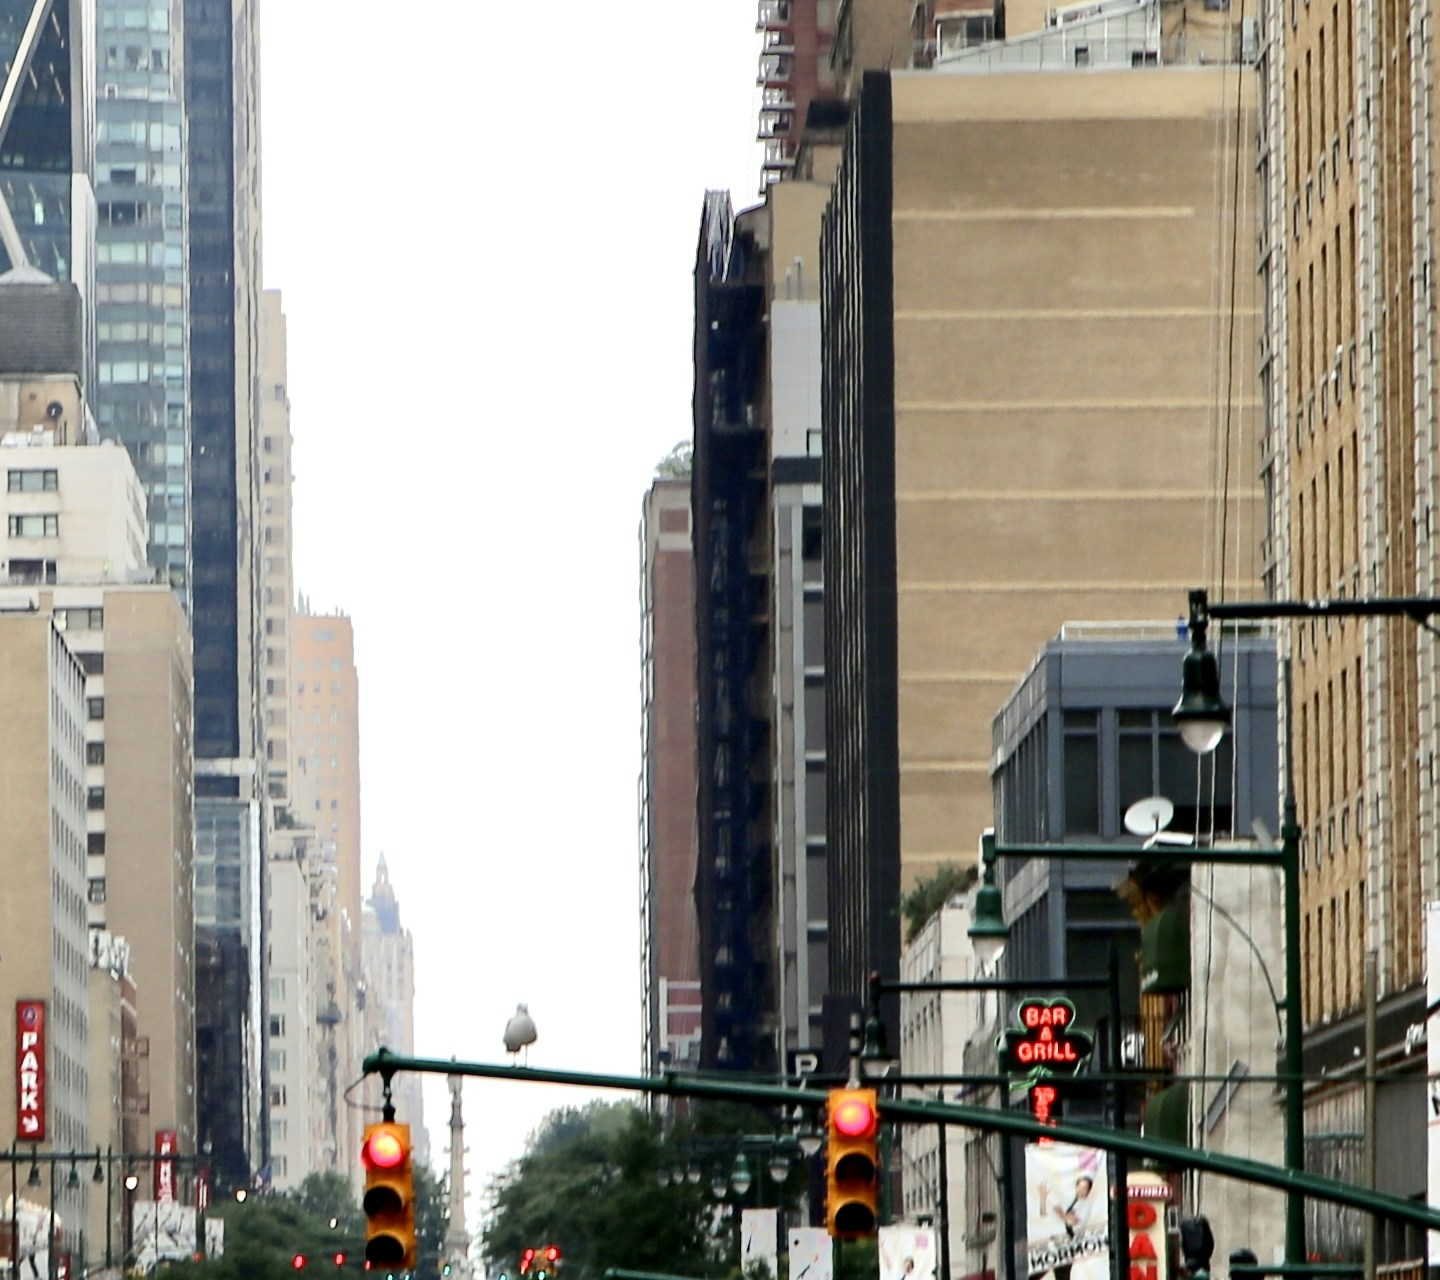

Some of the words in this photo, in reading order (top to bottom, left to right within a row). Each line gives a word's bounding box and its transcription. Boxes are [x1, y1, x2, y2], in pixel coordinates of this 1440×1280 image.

[1025, 1007, 1066, 1026] BAR
[1018, 1043, 1076, 1062] GRILL
[21, 1031, 39, 1111] PARK
